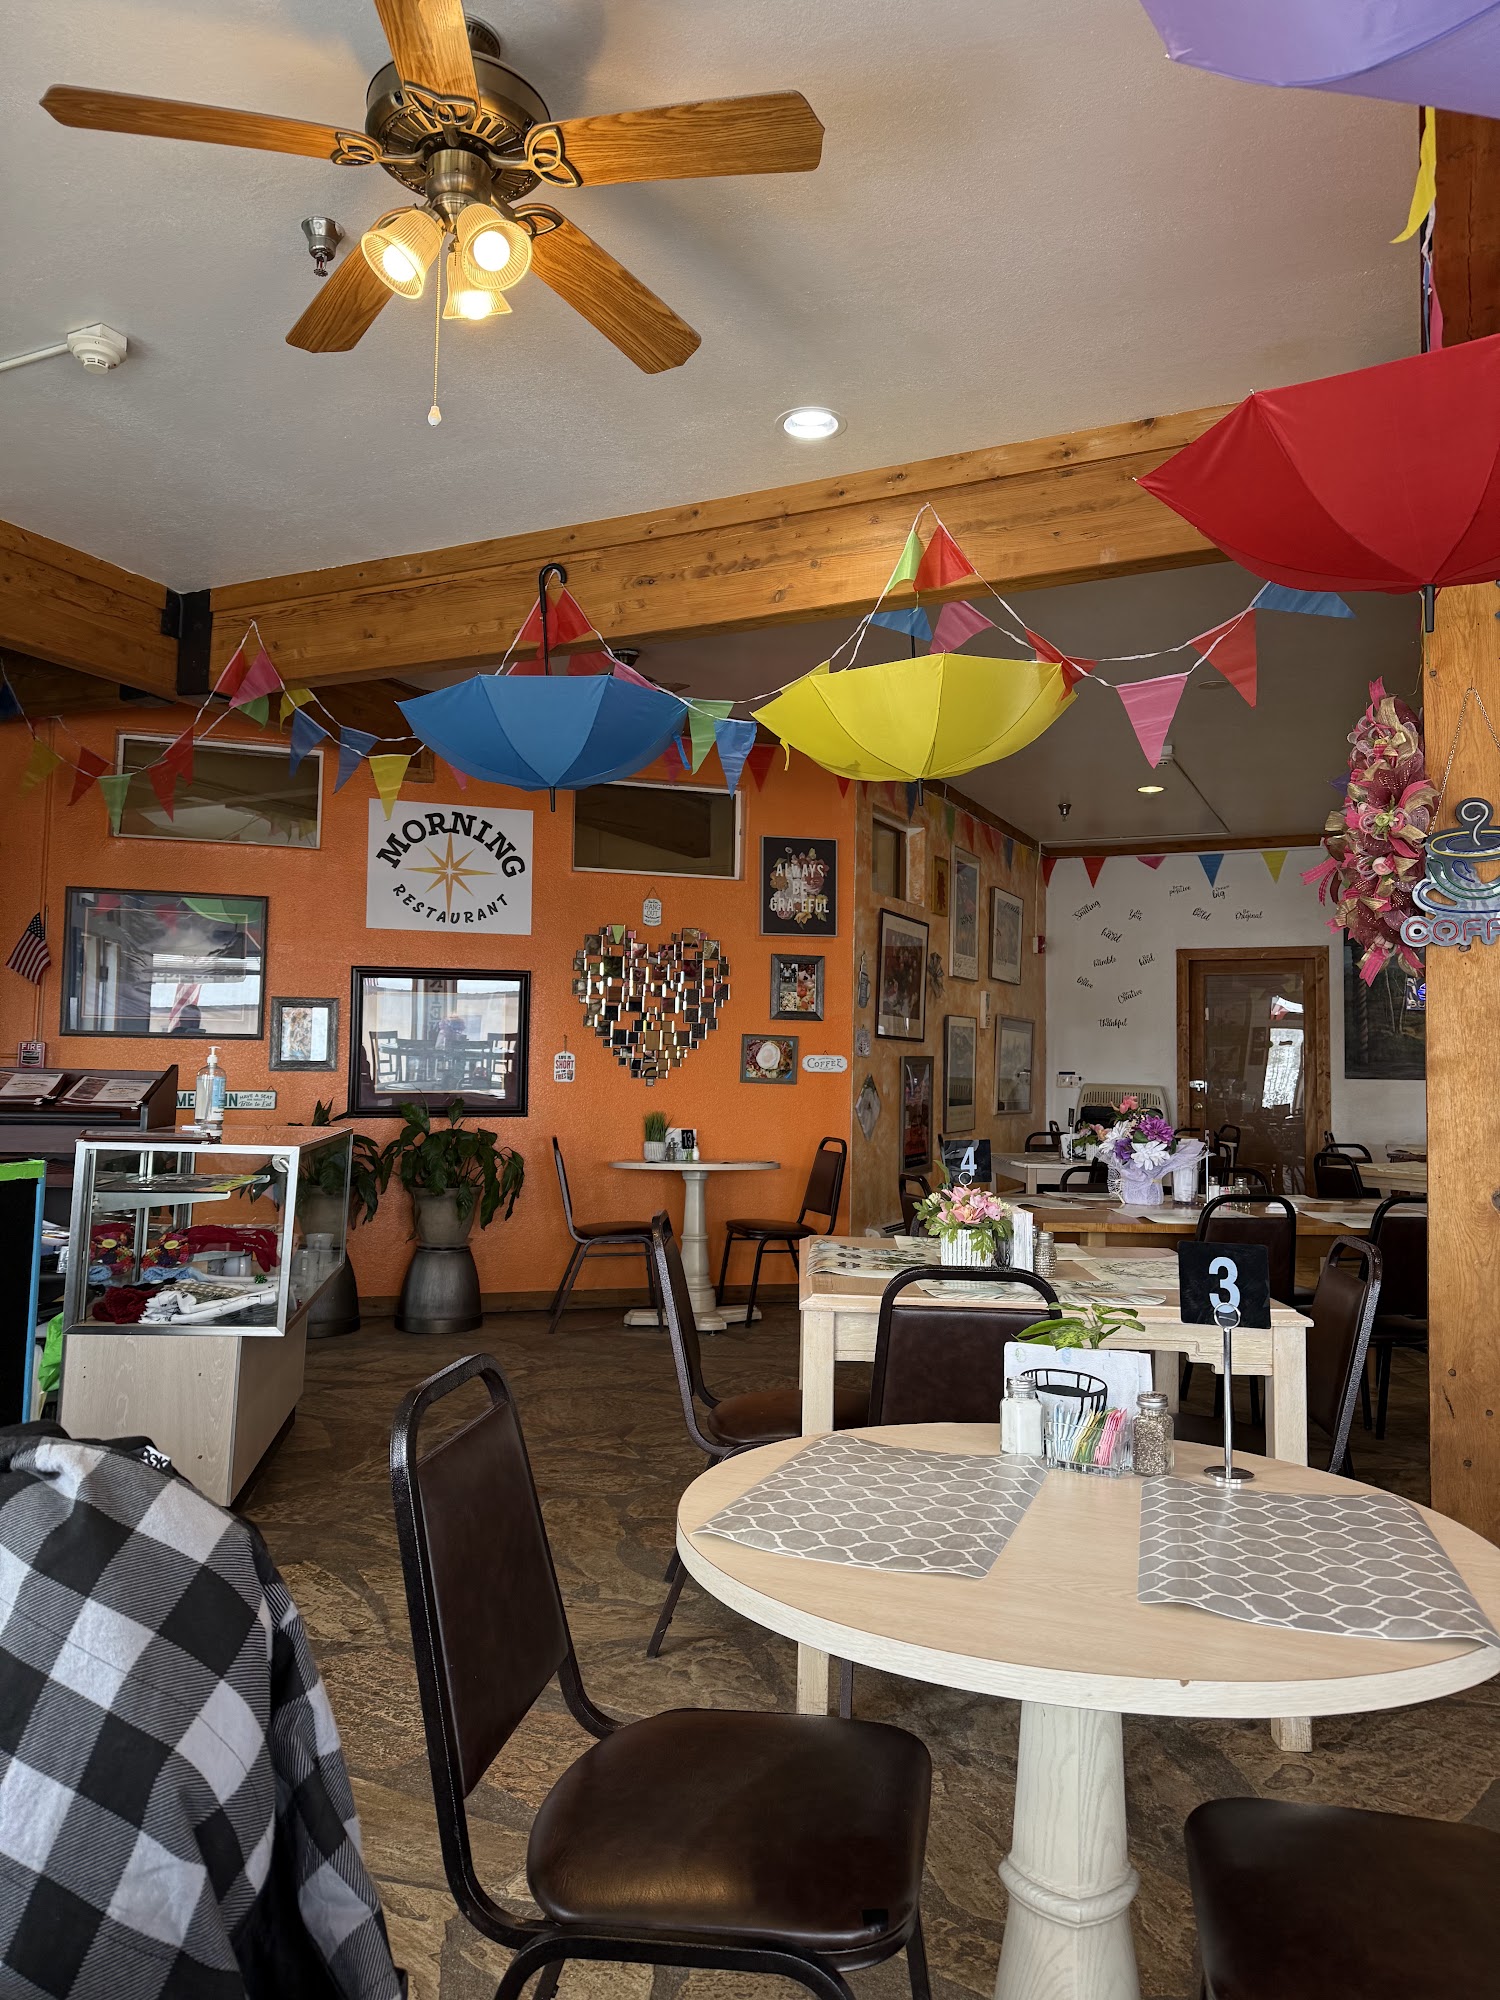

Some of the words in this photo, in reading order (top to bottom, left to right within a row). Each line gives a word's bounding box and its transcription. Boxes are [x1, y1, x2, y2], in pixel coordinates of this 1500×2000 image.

[375, 811, 526, 878] MORNING
[775, 862, 824, 878] ALWAYS
[792, 880, 807, 895] BE
[1212, 889, 1226, 899] big
[392, 883, 508, 924] RESTAURANT
[644, 903, 661, 911] HANG
[770, 897, 830, 913] GRATEFUL
[1072, 900, 1101, 921] Smiling
[1235, 911, 1263, 922] Original
[1100, 927, 1123, 943] hard
[21, 1043, 42, 1051] FIRE
[555, 1060, 574, 1069] SHORT
[806, 1057, 844, 1069] COFFEE
[176, 1092, 195, 1107] ME
[683, 1132, 693, 1147] 13
[960, 1146, 978, 1176] 4
[1208, 1256, 1241, 1314] 3
